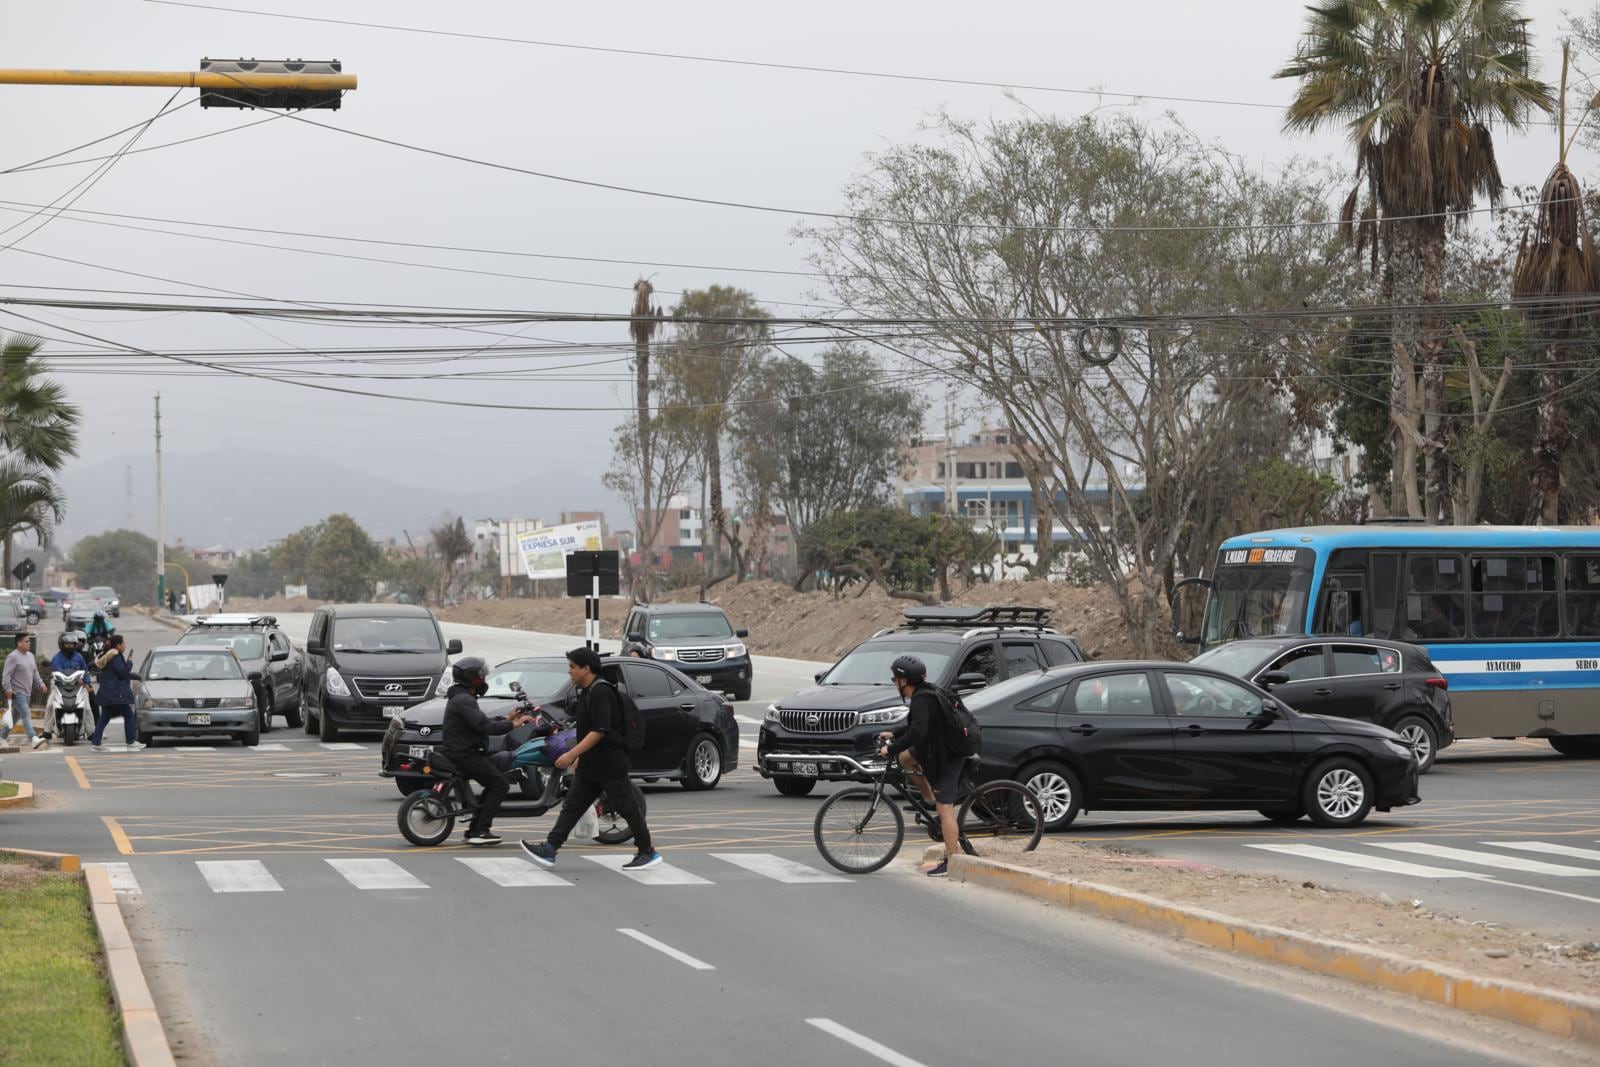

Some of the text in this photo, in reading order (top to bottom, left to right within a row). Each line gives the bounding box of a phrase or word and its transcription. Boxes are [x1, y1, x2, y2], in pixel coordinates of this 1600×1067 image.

[522, 539, 558, 552] EXPRESA
[559, 536, 576, 546] SUR
[1263, 549, 1297, 563] MIRAFLORES
[1486, 659, 1598, 671] AYACUCHO SURCO
